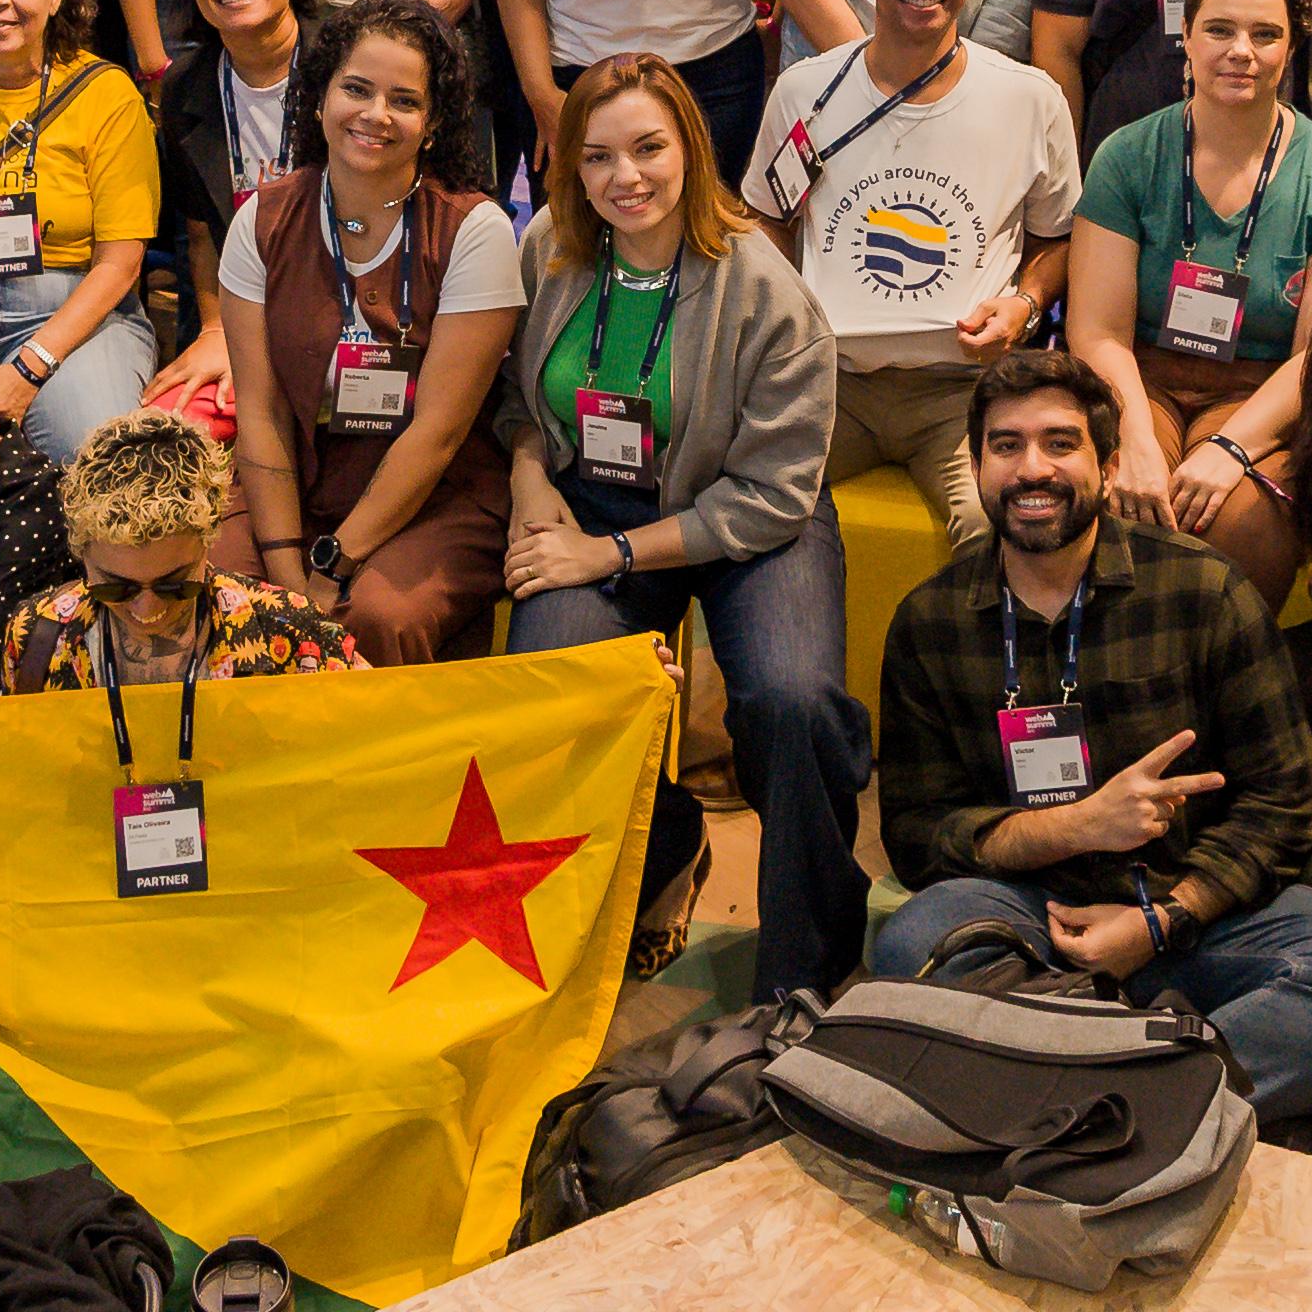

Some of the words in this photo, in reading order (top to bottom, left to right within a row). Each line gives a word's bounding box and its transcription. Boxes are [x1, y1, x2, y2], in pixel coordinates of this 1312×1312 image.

[822, 195, 853, 255] taking
[849, 172, 881, 203] you
[883, 166, 951, 199] around
[950, 182, 976, 213] the
[1173, 335, 1218, 355] PARTNER
[345, 419, 393, 431] PARTNER
[592, 466, 636, 481] PARTNER
[142, 797, 176, 808] summit
[1027, 790, 1077, 805] PARTNER
[136, 873, 189, 889] PARTNER
